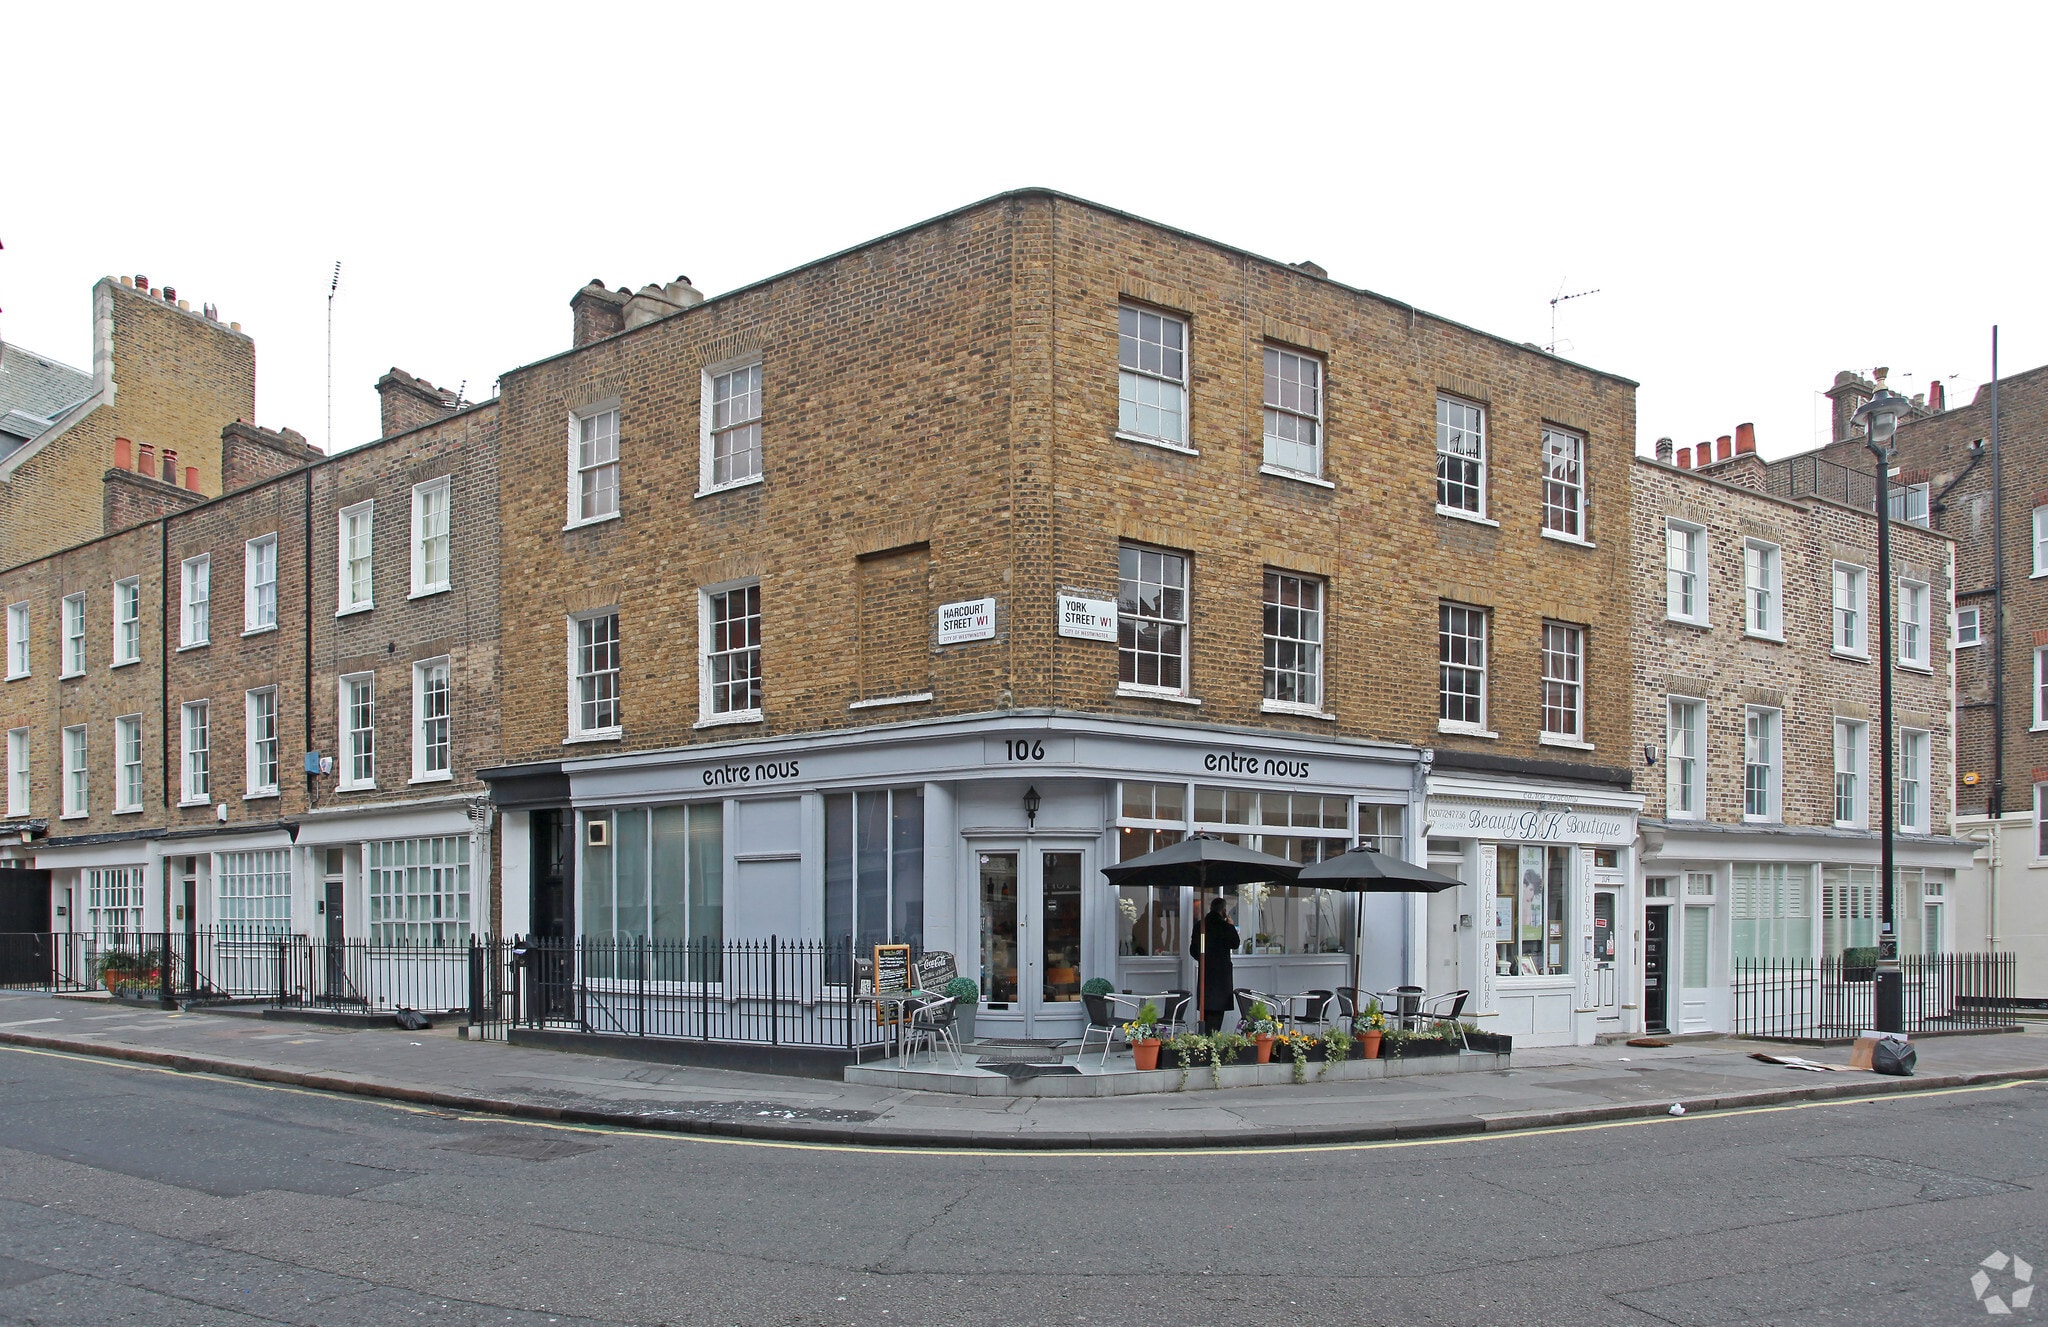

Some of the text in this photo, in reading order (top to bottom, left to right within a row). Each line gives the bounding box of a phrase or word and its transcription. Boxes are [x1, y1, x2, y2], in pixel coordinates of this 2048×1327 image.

[943, 603, 985, 619] HARCOURT
[1065, 600, 1087, 613] YORK
[943, 615, 989, 631] STREET W1
[1065, 612, 1112, 628] STREET W1
[958, 631, 987, 640] WESTMINSTER
[1081, 630, 1109, 639] WESTMINSTER
[1005, 739, 1045, 761] 106
[1204, 751, 1310, 778] entre nous
[702, 760, 800, 786] entre nous
[1468, 809, 1520, 839] Beauty
[1566, 815, 1621, 842] Boutique
